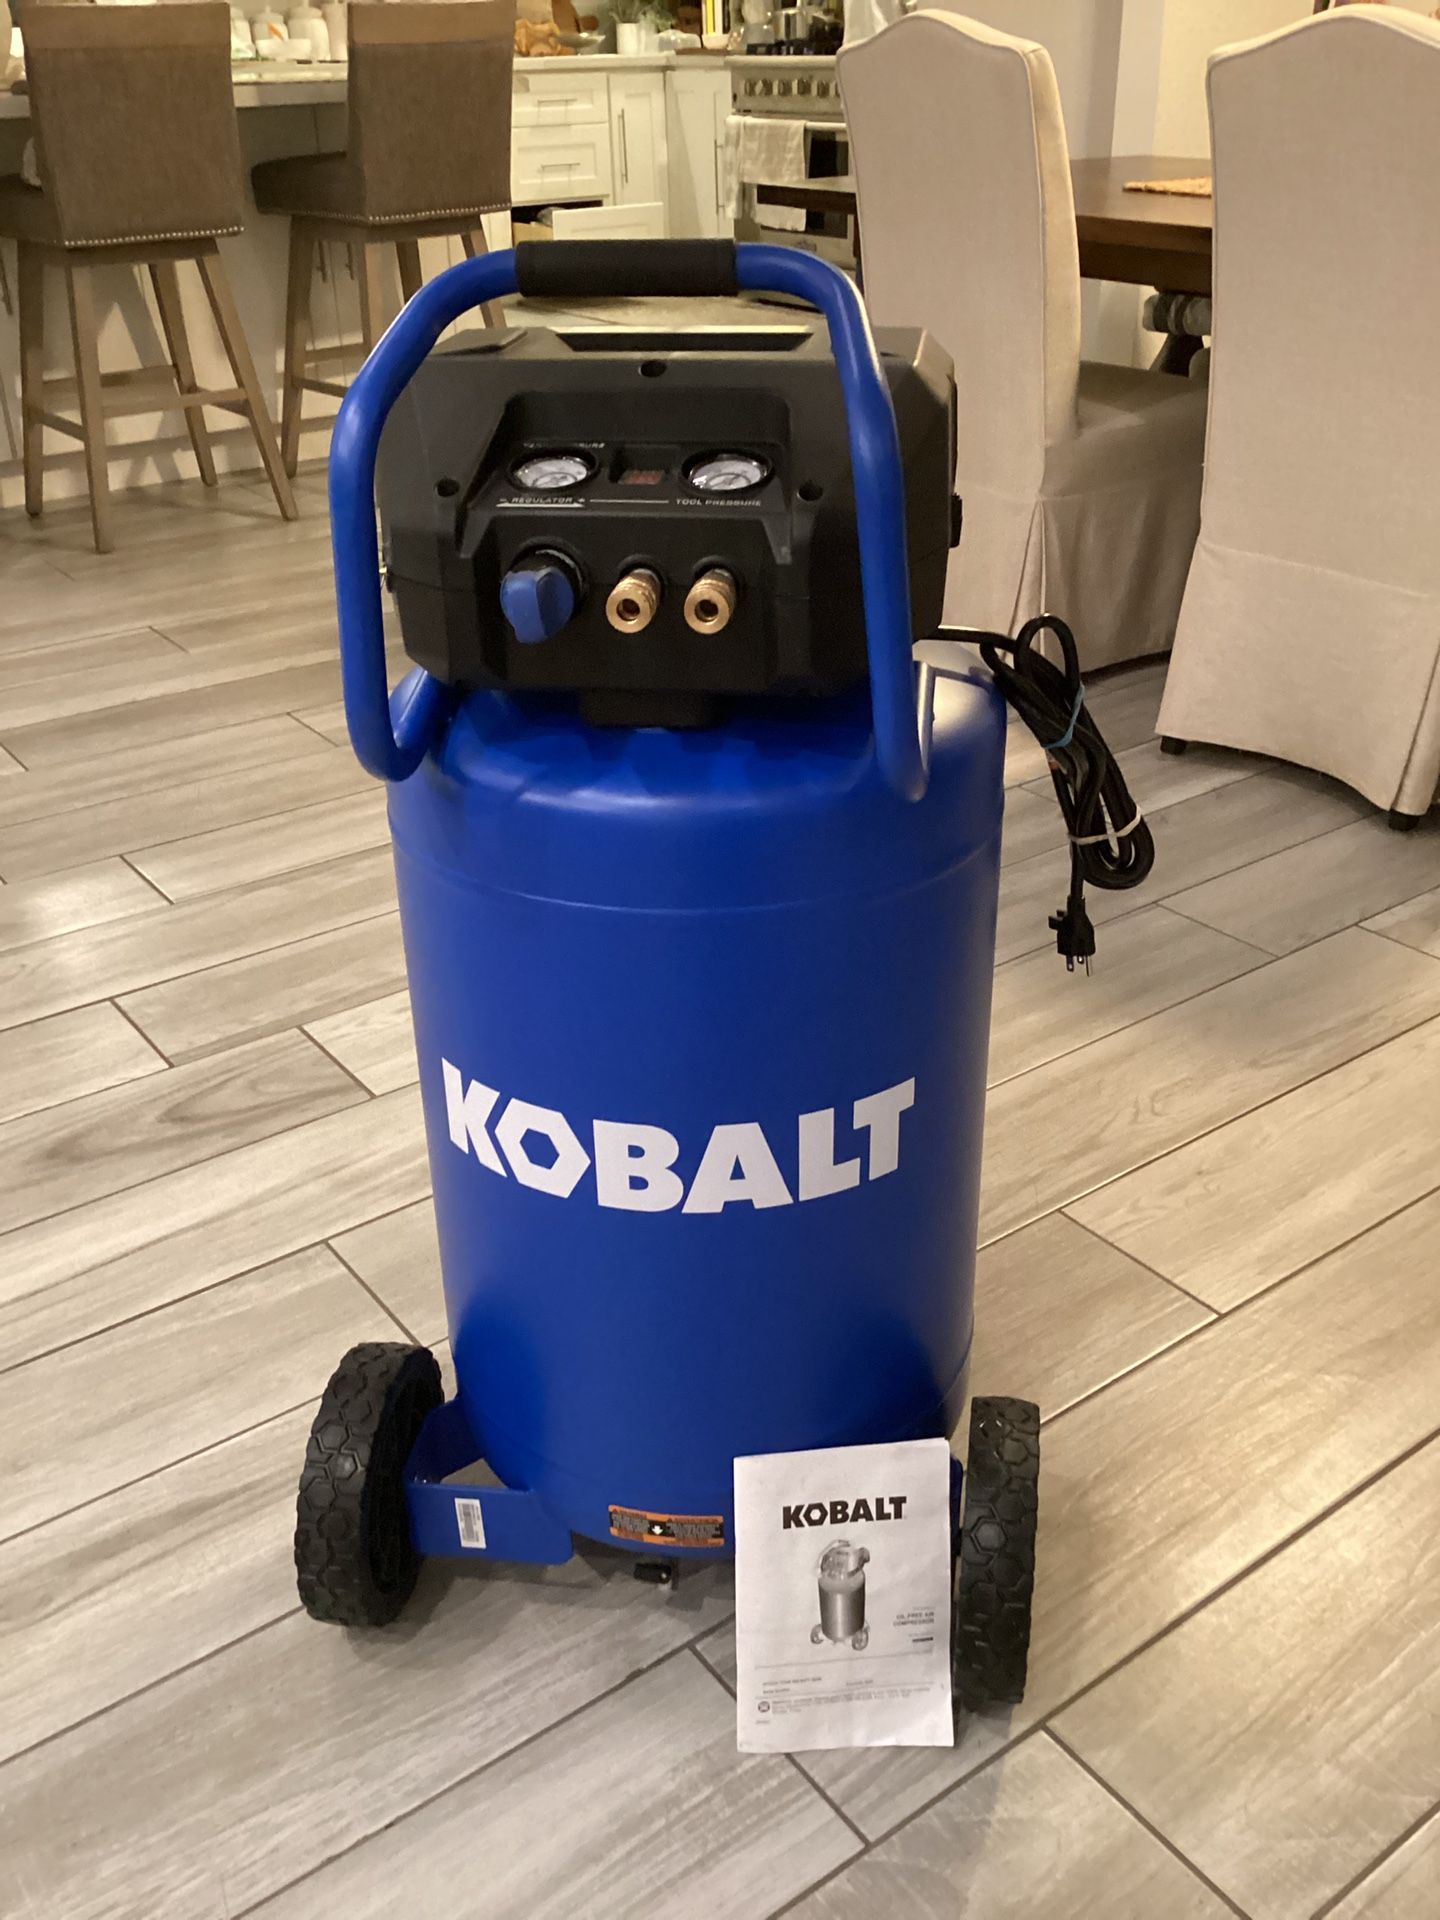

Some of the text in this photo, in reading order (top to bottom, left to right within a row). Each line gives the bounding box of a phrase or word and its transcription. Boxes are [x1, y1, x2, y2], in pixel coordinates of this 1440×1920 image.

[511, 496, 573, 504] REGULATOR
[704, 499, 762, 507] PRESSURE
[441, 1057, 915, 1213] KOBALT
[782, 1496, 907, 1529] KOBALT
